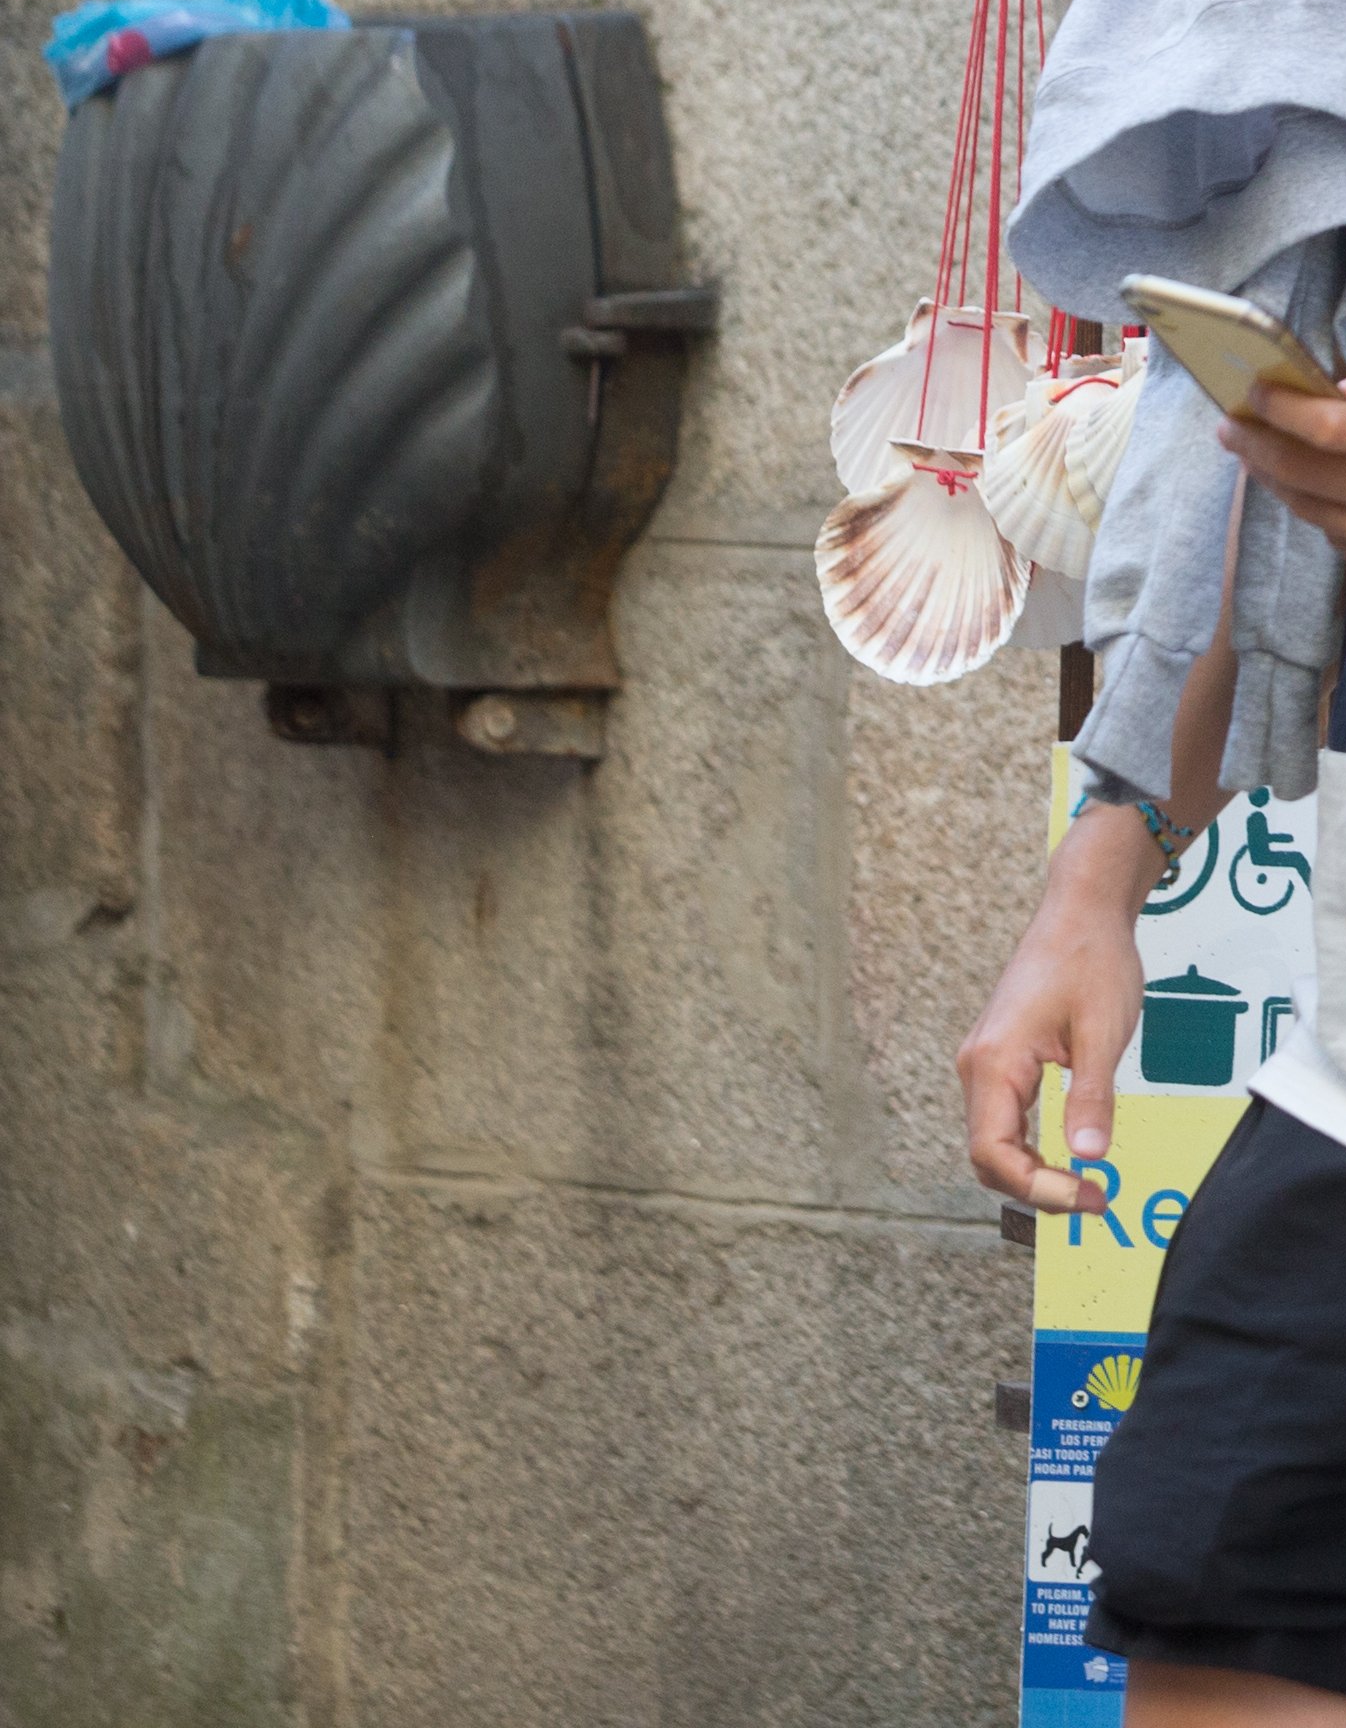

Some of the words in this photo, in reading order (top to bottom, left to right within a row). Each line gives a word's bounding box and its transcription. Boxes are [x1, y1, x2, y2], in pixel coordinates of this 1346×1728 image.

[1068, 1157, 1191, 1250] Re
[1061, 1434, 1080, 1446] LOS
[1030, 1447, 1052, 1460] CASI
[1054, 1448, 1090, 1461] TODOS
[1034, 1462, 1070, 1475] HOGAR
[1073, 1464, 1094, 1476] PAR
[1037, 1588, 1085, 1602] PILGRIM,
[1031, 1603, 1045, 1614] TO
[1048, 1618, 1076, 1630] HAVE
[1028, 1632, 1084, 1646] HOMELESS
